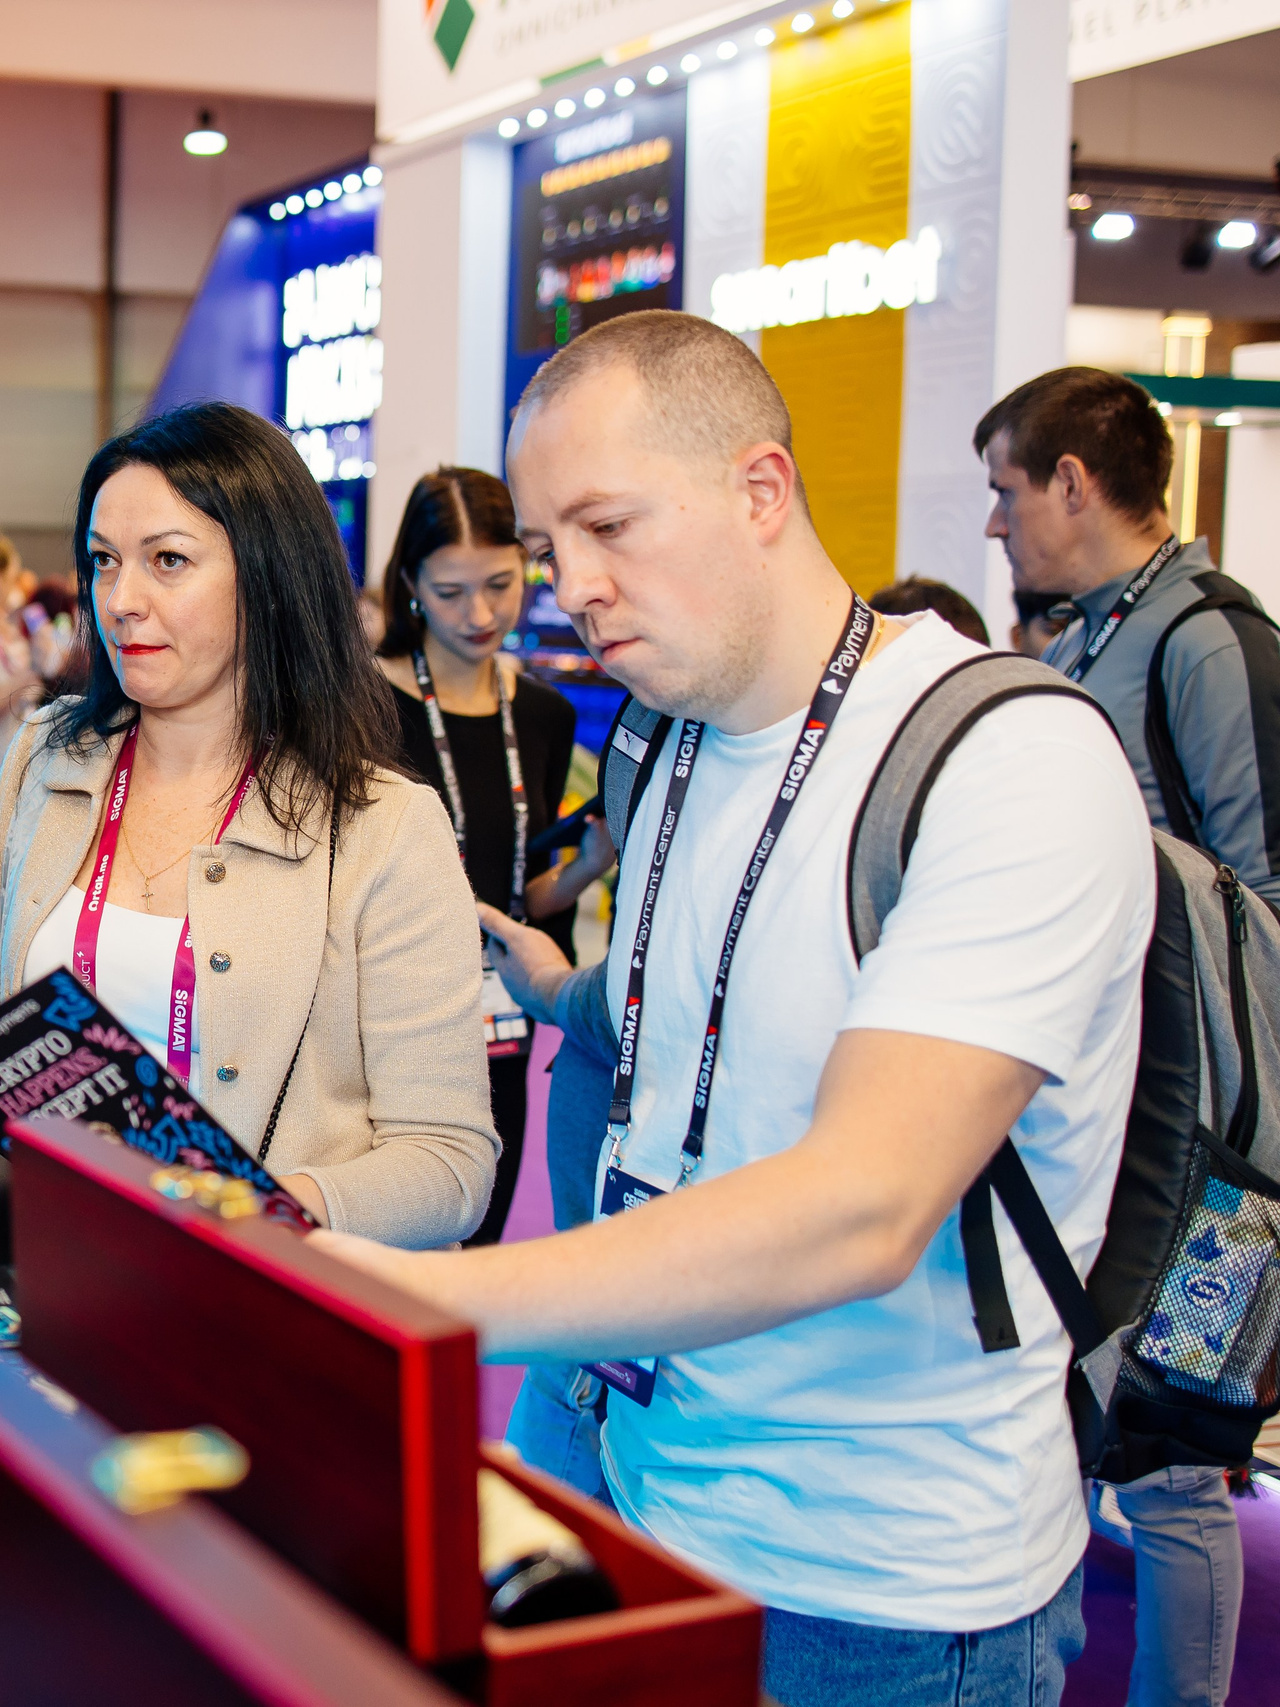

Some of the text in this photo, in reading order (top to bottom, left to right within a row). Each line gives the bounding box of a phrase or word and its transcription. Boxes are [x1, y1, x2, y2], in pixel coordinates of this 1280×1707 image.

[829, 606, 870, 678] Payment
[634, 805, 678, 951] Payment Center
[718, 827, 776, 978] Payment Center
